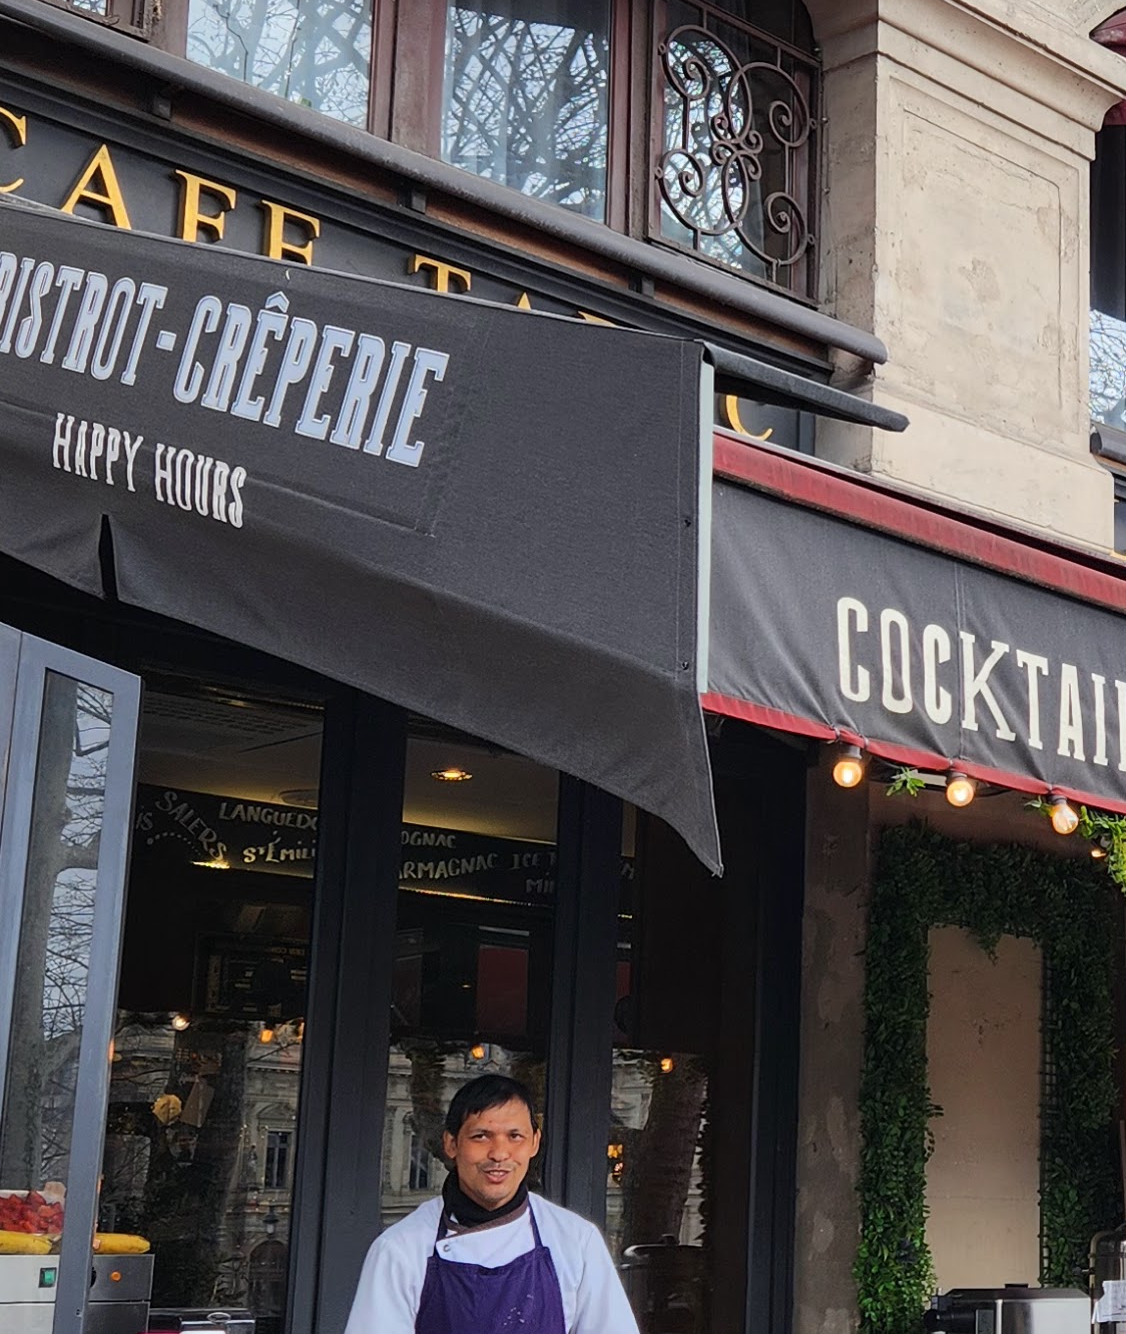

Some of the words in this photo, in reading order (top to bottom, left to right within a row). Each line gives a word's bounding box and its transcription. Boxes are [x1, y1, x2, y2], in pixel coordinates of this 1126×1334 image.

[52, 413, 143, 492] HAPPY
[154, 443, 248, 529] HOURS
[155, 790, 227, 862] SALERS
[401, 830, 457, 849] OGNAC
